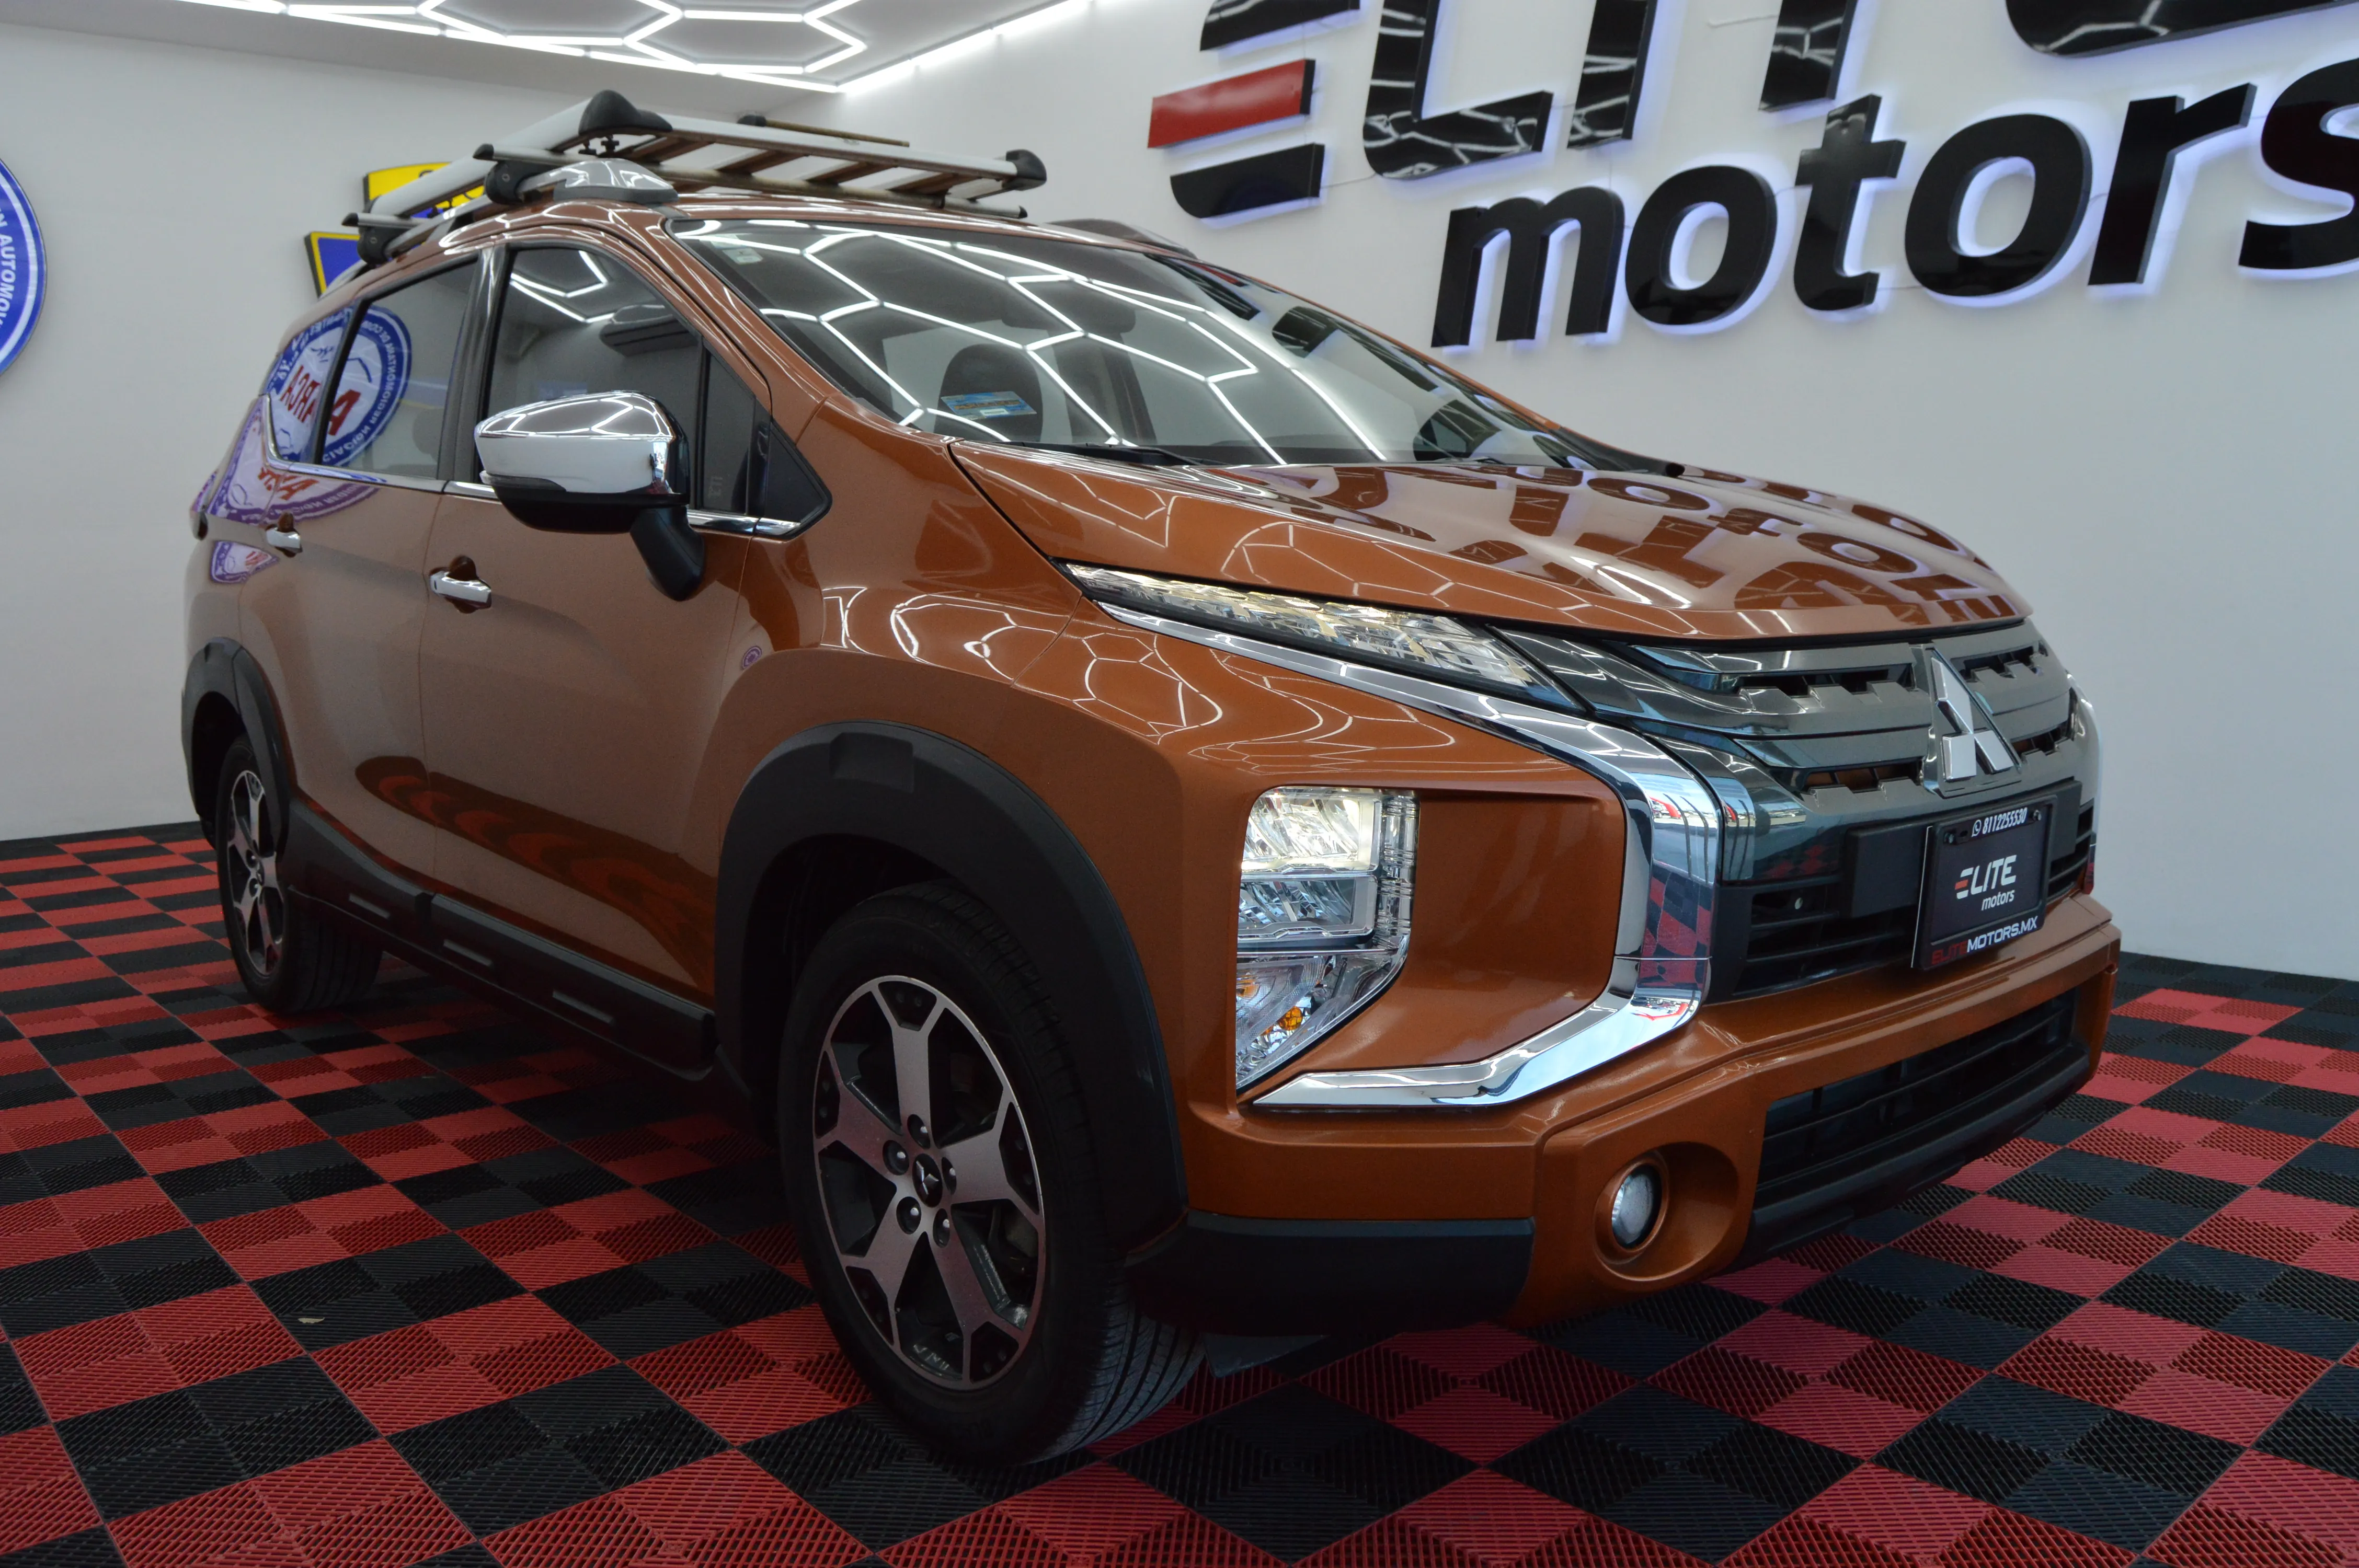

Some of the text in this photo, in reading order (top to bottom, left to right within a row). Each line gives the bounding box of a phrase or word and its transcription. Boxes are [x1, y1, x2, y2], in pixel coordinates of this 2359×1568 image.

[1148, 0, 2359, 218] ELI
[1431, 57, 2359, 348] motors
[1982, 807, 2028, 835] 8112255530
[1954, 855, 2017, 900] ELITE
[1981, 890, 2016, 911] motors
[1931, 916, 2039, 965] ELITEMOTORS.MX
